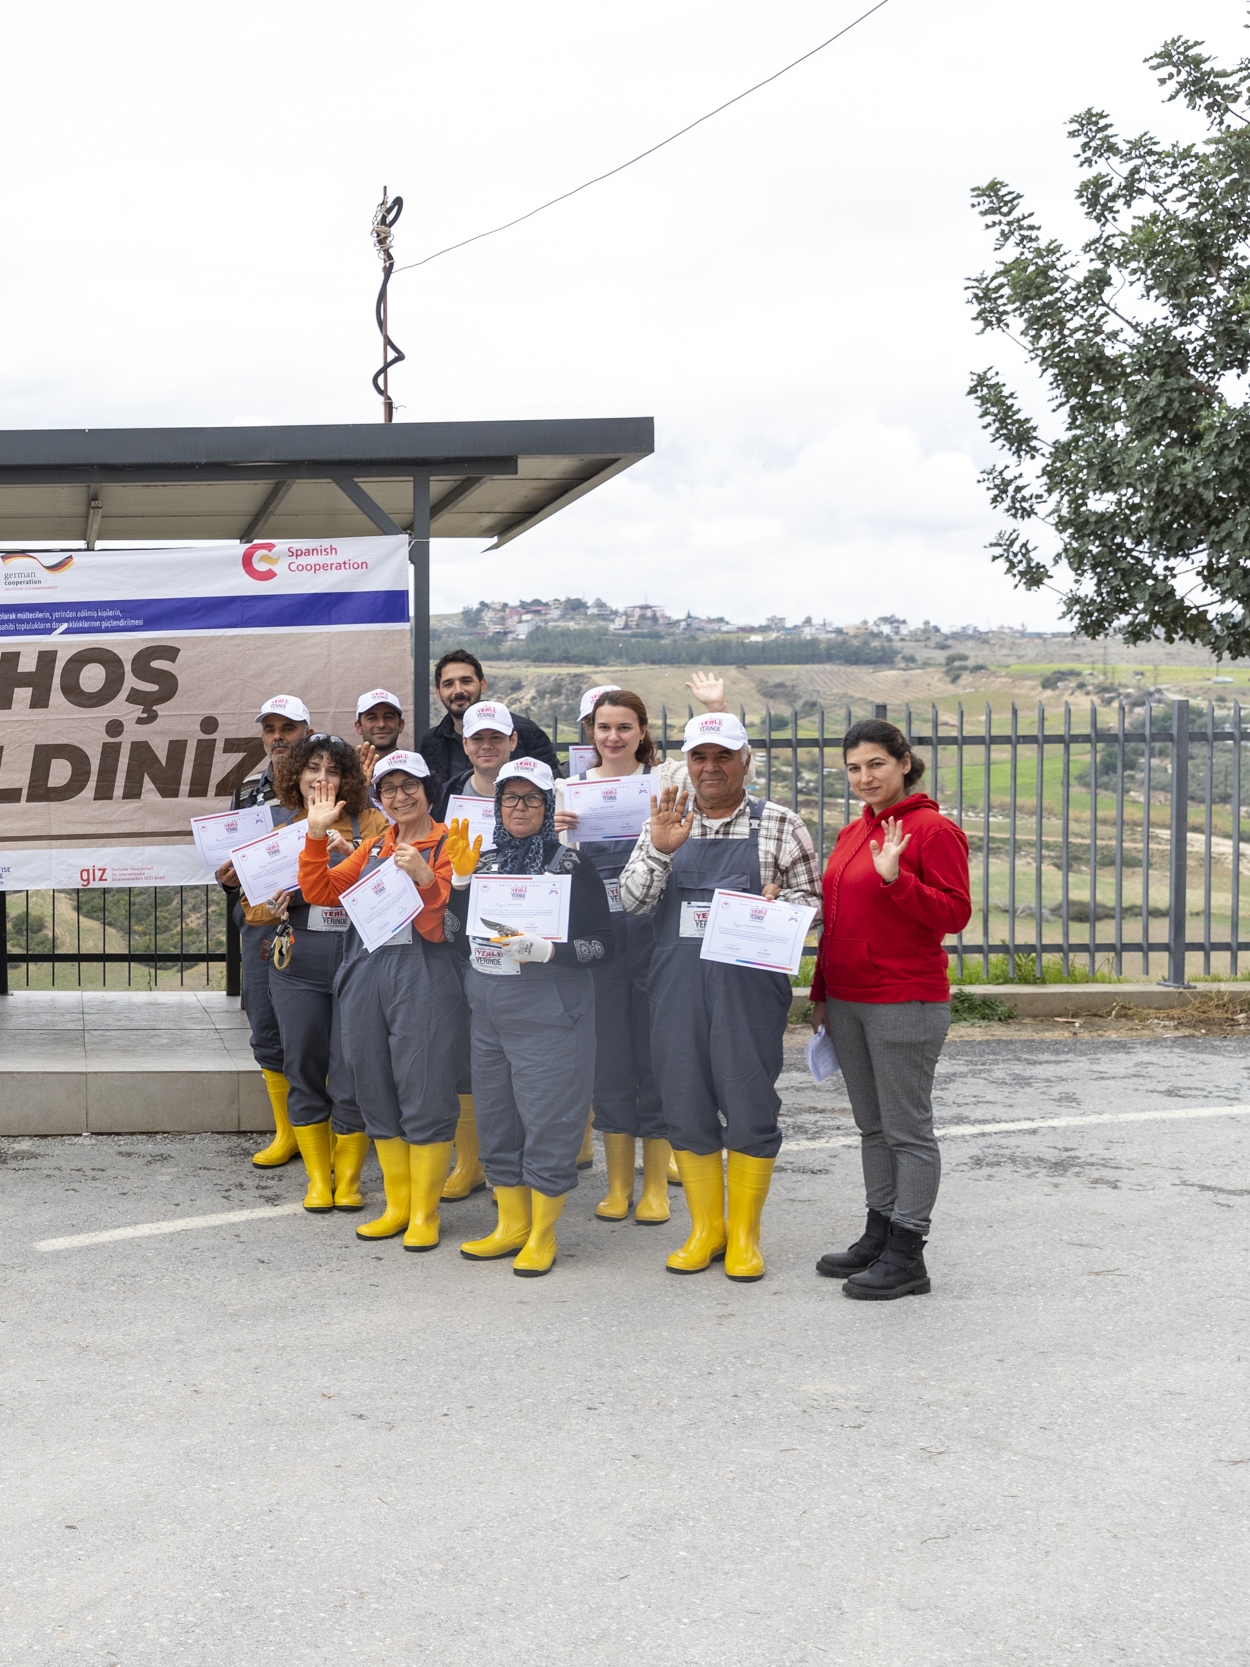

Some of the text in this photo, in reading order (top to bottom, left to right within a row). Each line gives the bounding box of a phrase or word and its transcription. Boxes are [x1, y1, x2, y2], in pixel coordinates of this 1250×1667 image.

[287, 545, 338, 559] Spanish
[288, 559, 368, 574] Cooperation
[4, 571, 36, 581] german
[17, 611, 52, 620] mültecilerin,
[52, 610, 77, 619] yerinden
[77, 609, 97, 618] edilmiş
[98, 608, 122, 617] kişilerin,
[15, 622, 51, 631] toplulukların
[101, 618, 143, 628] güçlendirilmesi
[80, 864, 107, 887] giz
